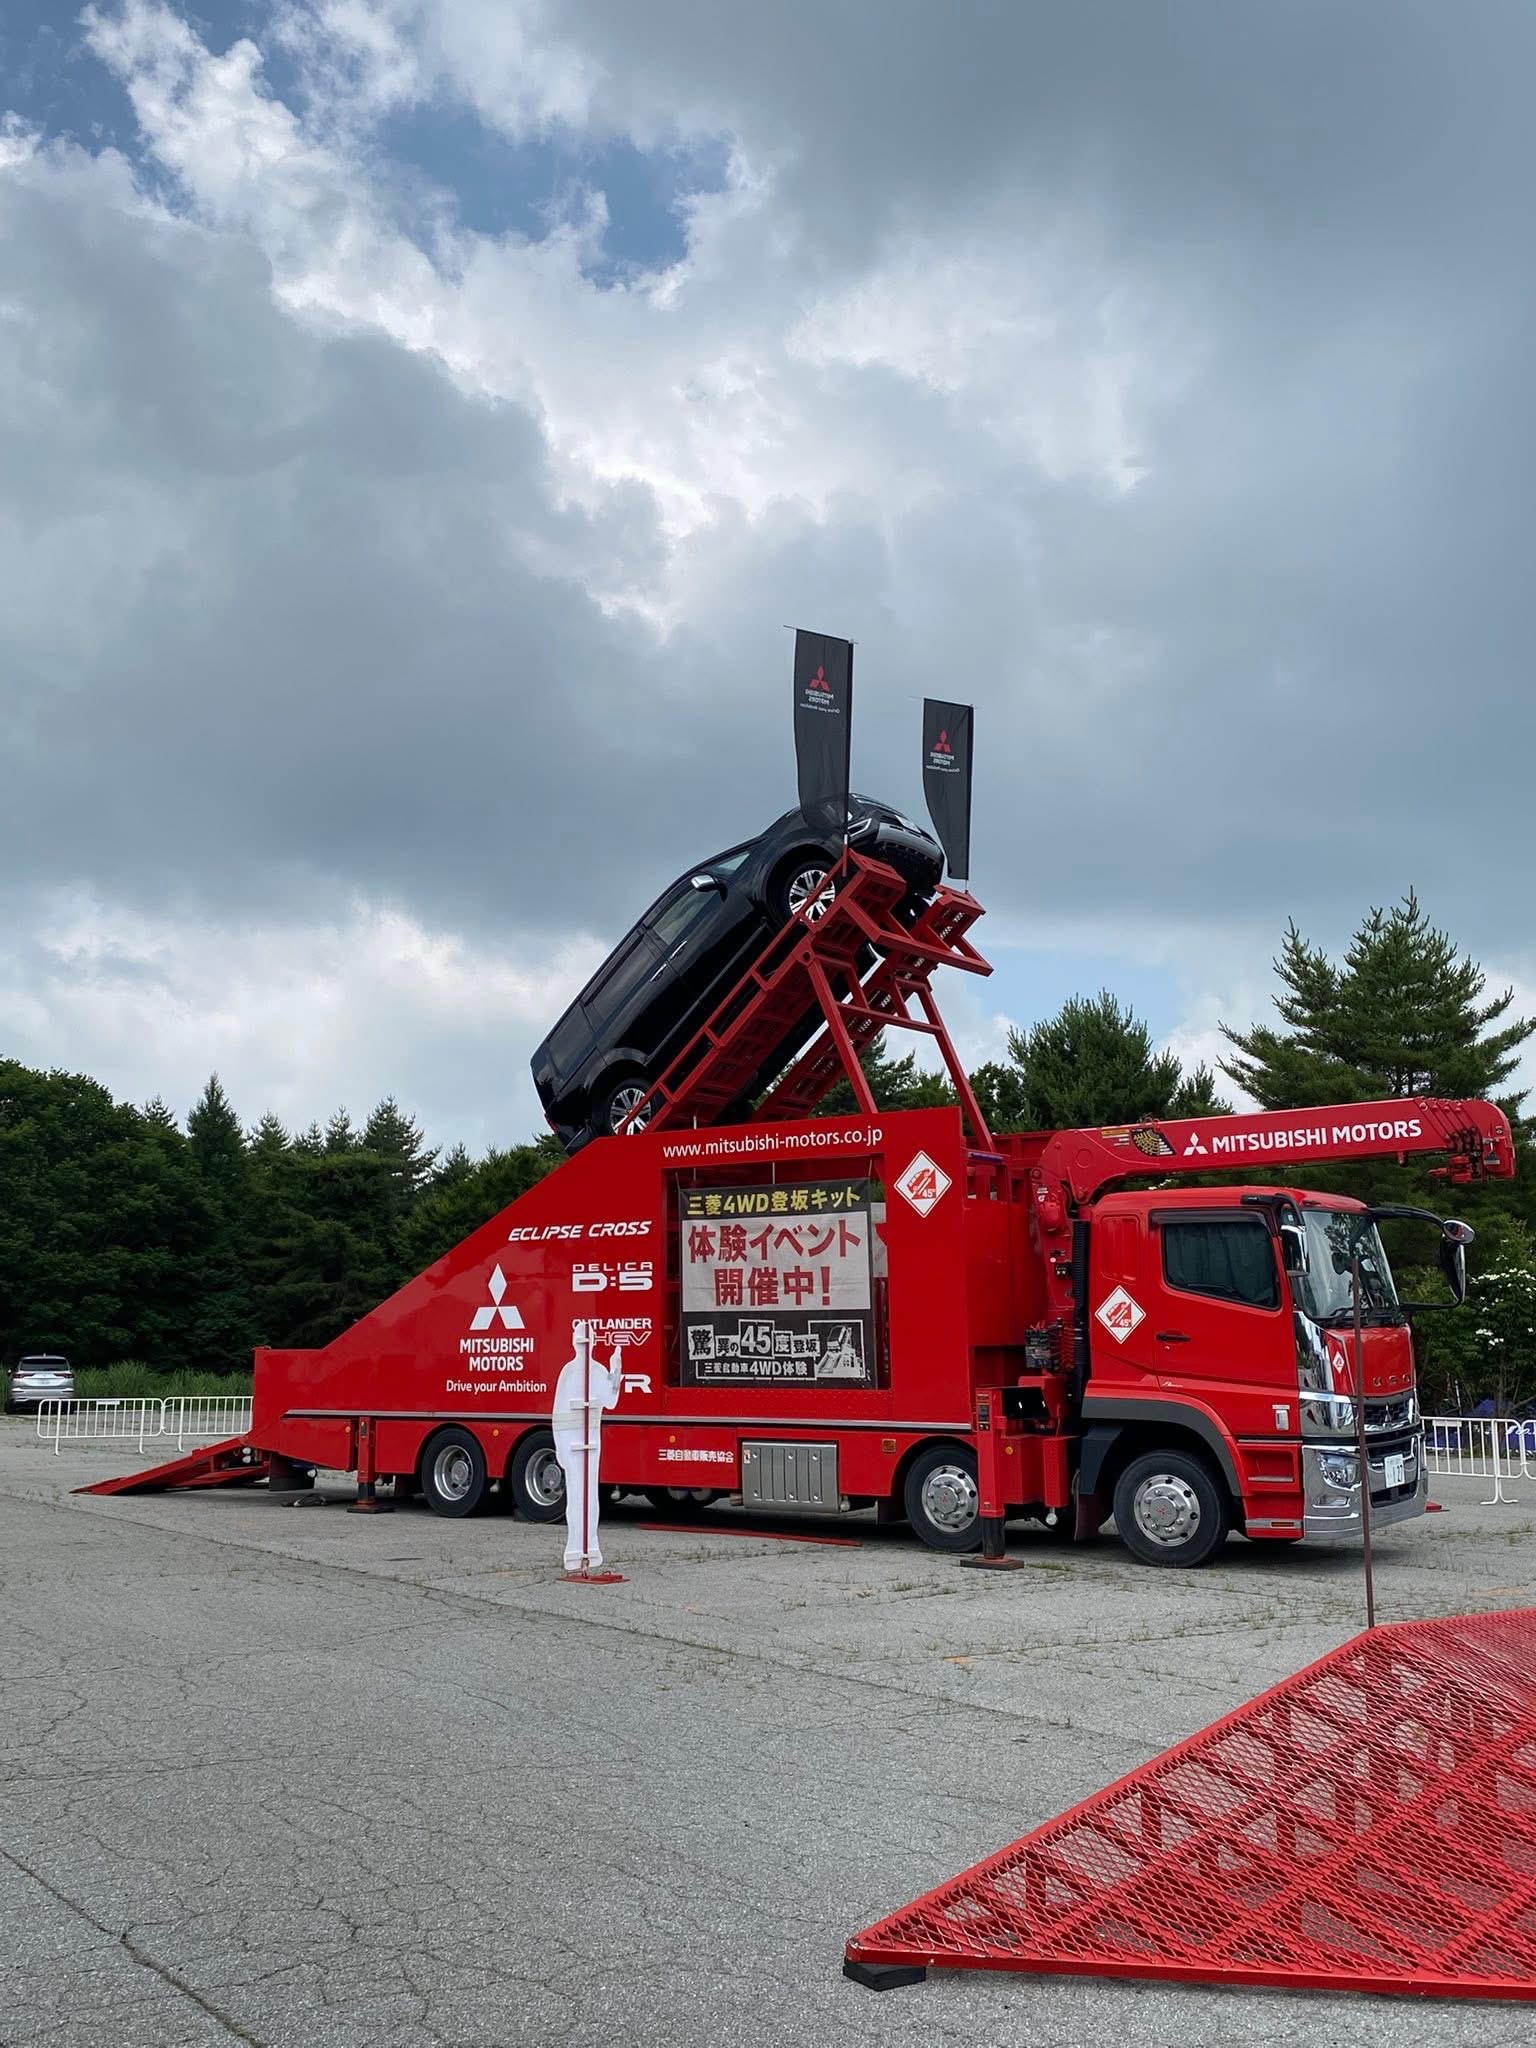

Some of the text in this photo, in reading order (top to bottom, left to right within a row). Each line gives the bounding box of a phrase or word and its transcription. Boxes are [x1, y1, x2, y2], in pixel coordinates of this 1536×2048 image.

[663, 1125, 883, 1158] www.mitsubishi-motors.co.jp
[1212, 1119, 1422, 1153] MITSUBISHI MOTORS
[687, 1186, 861, 1216] 三菱4WD登坂キット
[508, 1221, 652, 1241] ECLIPSE CROSS
[688, 1219, 861, 1263] 体験イベント
[572, 1262, 653, 1272] DELICA
[572, 1271, 653, 1292] D:5
[460, 1337, 534, 1354] MITSUBISHI
[469, 1356, 524, 1372] MOTORS
[446, 1379, 547, 1395] Drive your Ambition
